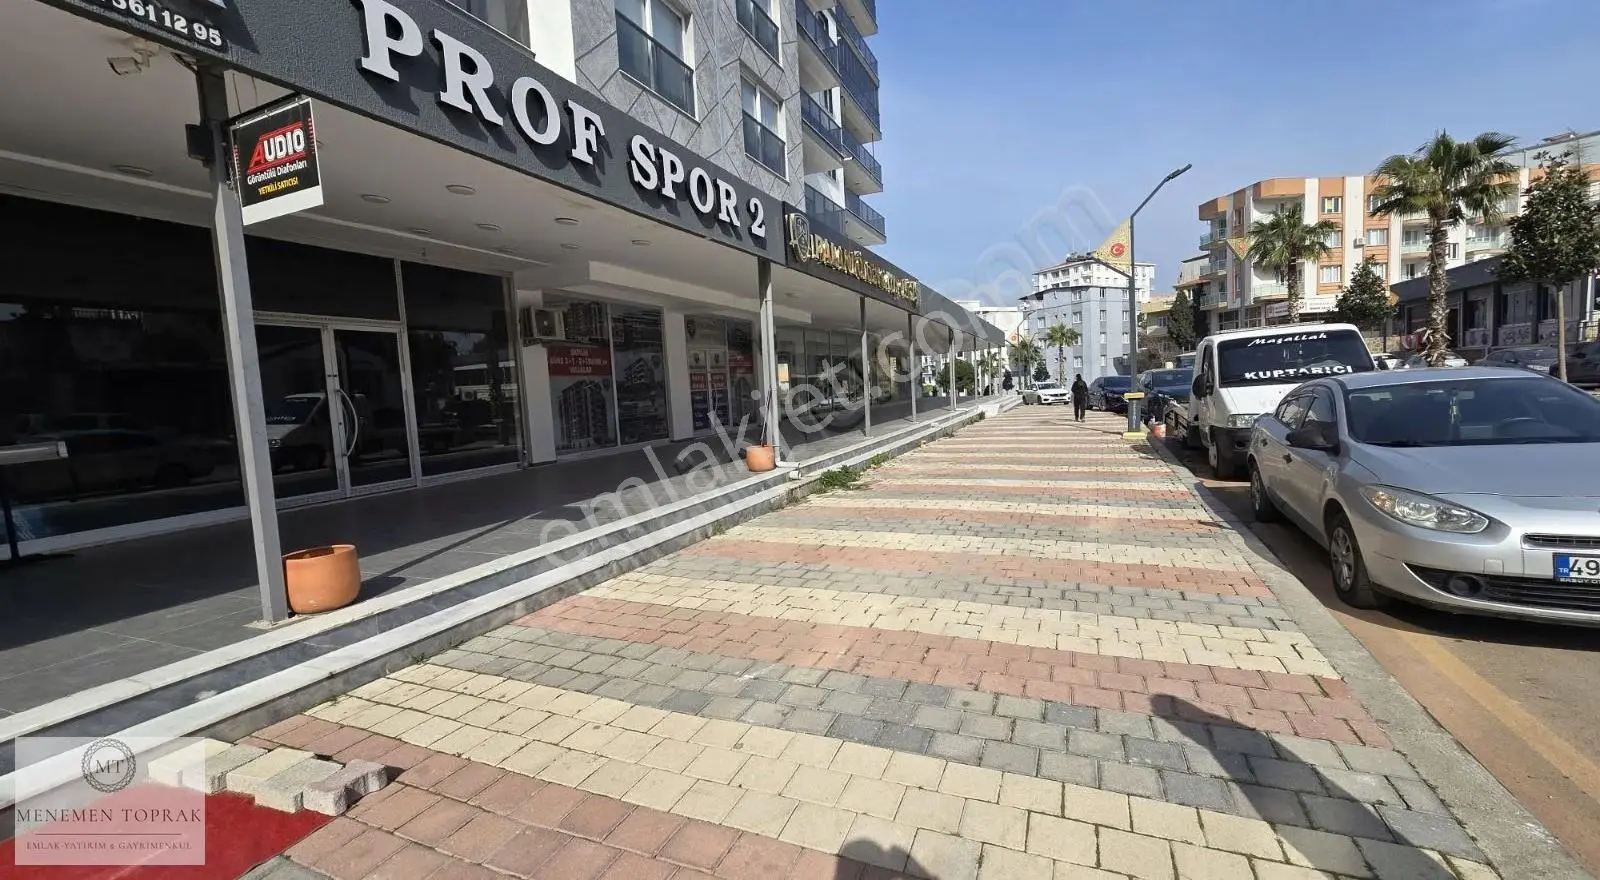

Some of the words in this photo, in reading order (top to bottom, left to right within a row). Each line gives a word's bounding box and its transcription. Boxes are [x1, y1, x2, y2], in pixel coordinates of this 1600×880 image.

[161, 10, 188, 34] 12
[192, 22, 223, 47] 95
[360, 0, 606, 165] PROF
[629, 134, 741, 227] SPOR
[749, 196, 767, 238] 2
[249, 128, 305, 169] AUDIO
[247, 168, 277, 185] Görüntülü
[1570, 559, 1600, 576] 49
